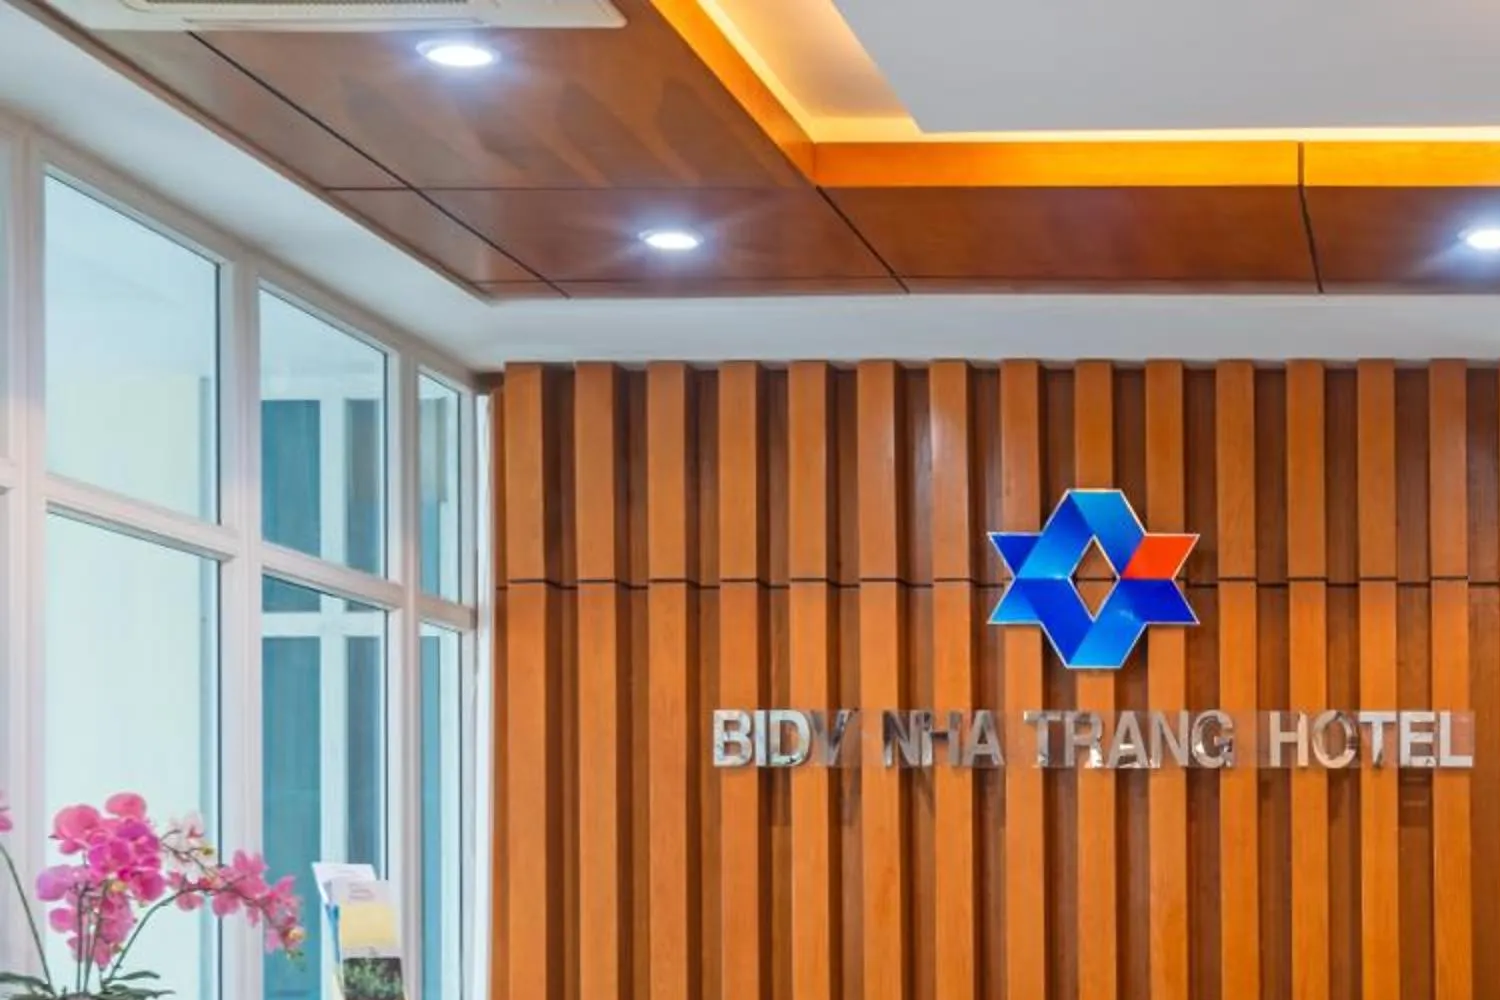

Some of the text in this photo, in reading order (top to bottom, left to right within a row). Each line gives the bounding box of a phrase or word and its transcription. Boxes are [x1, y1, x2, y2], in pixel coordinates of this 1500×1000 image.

[712, 708, 1473, 768] BIDV NHA TRANG HOTEL
